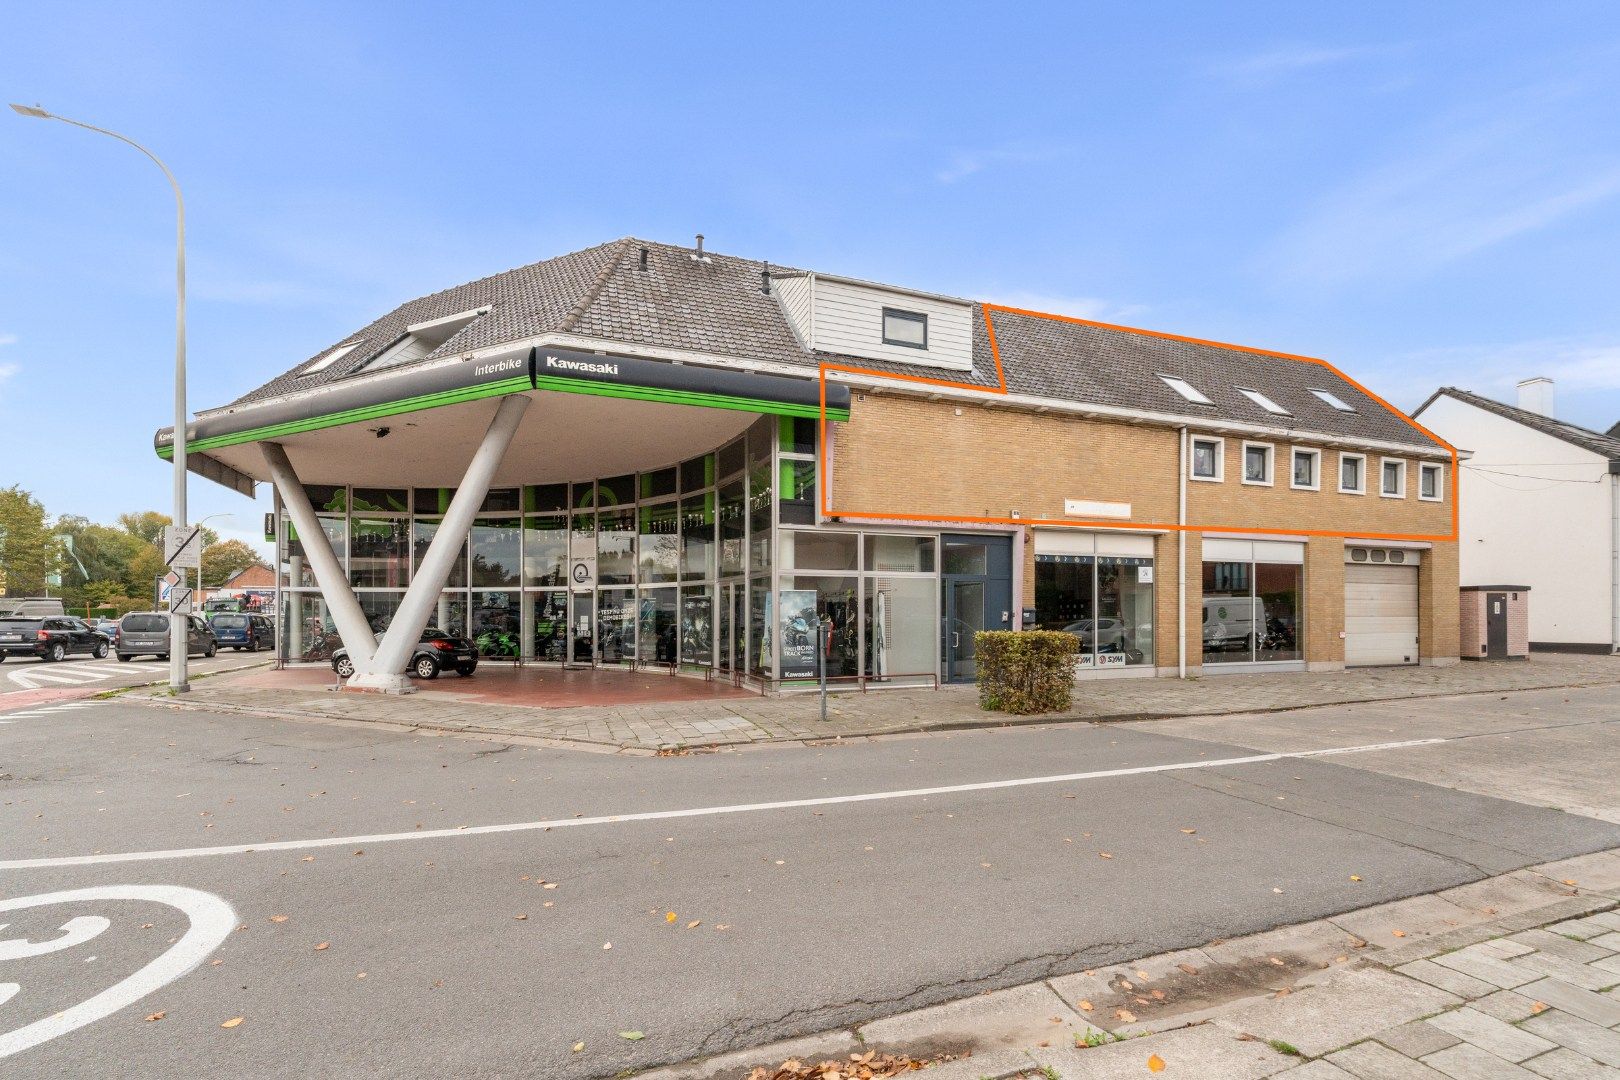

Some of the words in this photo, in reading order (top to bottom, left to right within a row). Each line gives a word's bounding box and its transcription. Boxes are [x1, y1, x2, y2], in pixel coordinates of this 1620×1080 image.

[475, 358, 522, 376] Interbike
[546, 356, 619, 375] Kawasaki
[158, 432, 174, 441] Kawa
